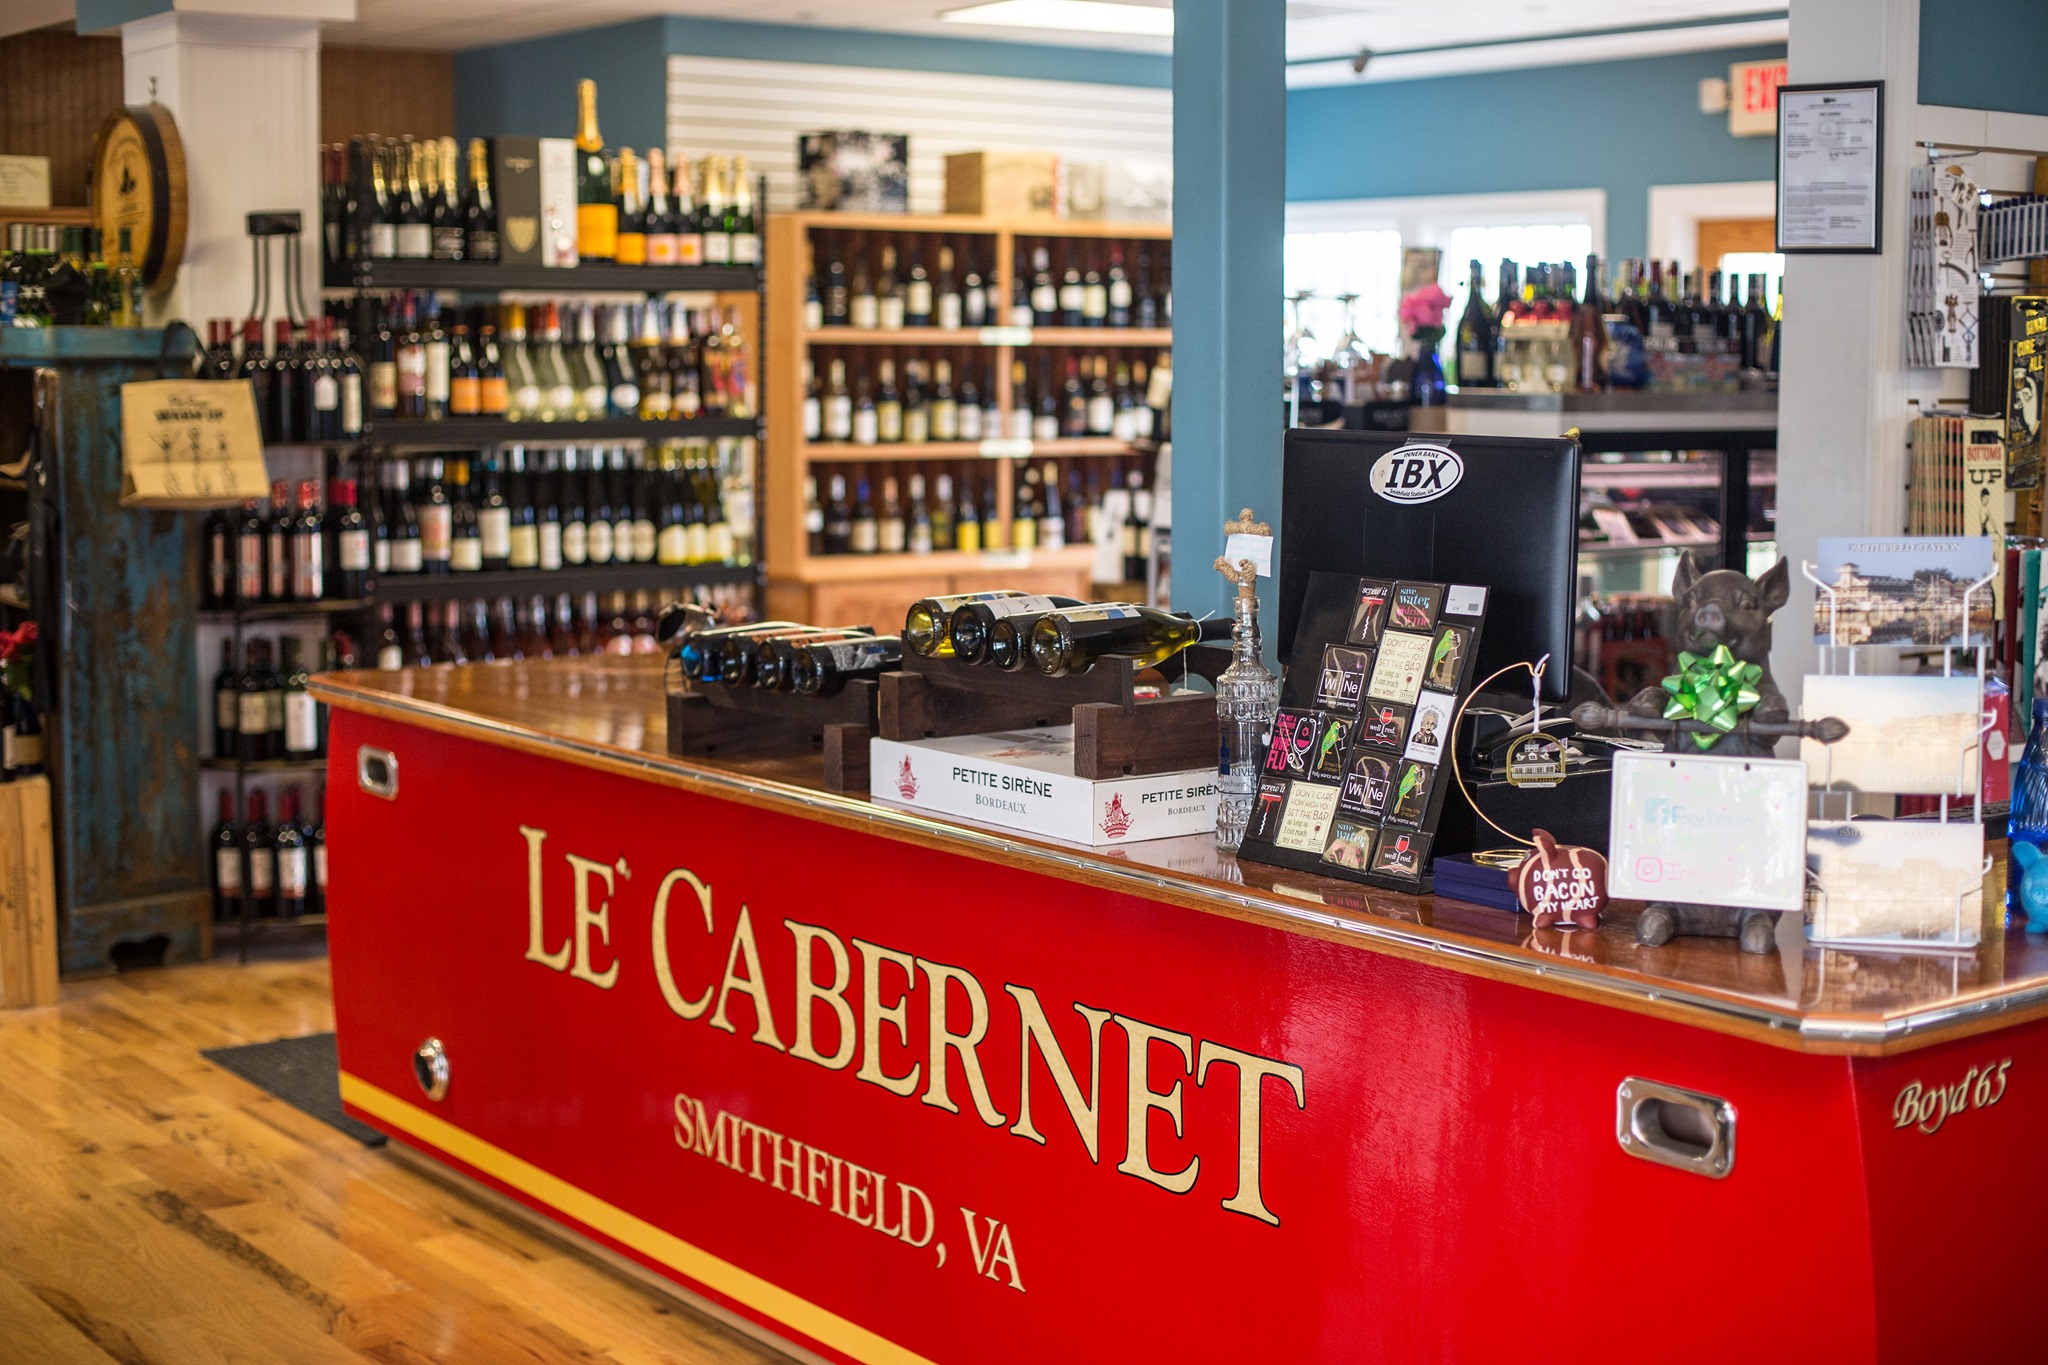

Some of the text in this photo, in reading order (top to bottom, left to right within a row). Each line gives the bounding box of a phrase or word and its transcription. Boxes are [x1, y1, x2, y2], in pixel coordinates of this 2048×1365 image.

[1967, 445, 2002, 461] BOTTOMS
[1386, 459, 1451, 488] IBX
[1968, 469, 2002, 484] UP
[1849, 542, 1961, 552] SMITHFIELD STATION
[1378, 658, 1421, 673] SET THE BAR
[1324, 678, 1358, 693] Wi Ne
[1369, 723, 1381, 732] well
[1266, 750, 1289, 770] FLU
[952, 767, 1052, 798] PETITE SIRÈNE
[1141, 783, 1220, 804] PETITE SIRÈN
[1316, 791, 1334, 801] CARE
[1349, 782, 1383, 800] Wi Ne
[975, 793, 1026, 814] BORDEAUX
[1168, 805, 1206, 815] BORDEAUX
[1287, 808, 1299, 816] SET
[1300, 809, 1312, 819] THE
[1360, 806, 1381, 817] periodically
[1384, 852, 1397, 860] well
[1533, 867, 1591, 882] DON'T GO
[1533, 880, 1595, 901] BACON
[1538, 896, 1599, 913] MY HEART
[651, 867, 1306, 1229] CABERNET
[673, 1092, 1028, 1293] SMITHFIELD, VA
